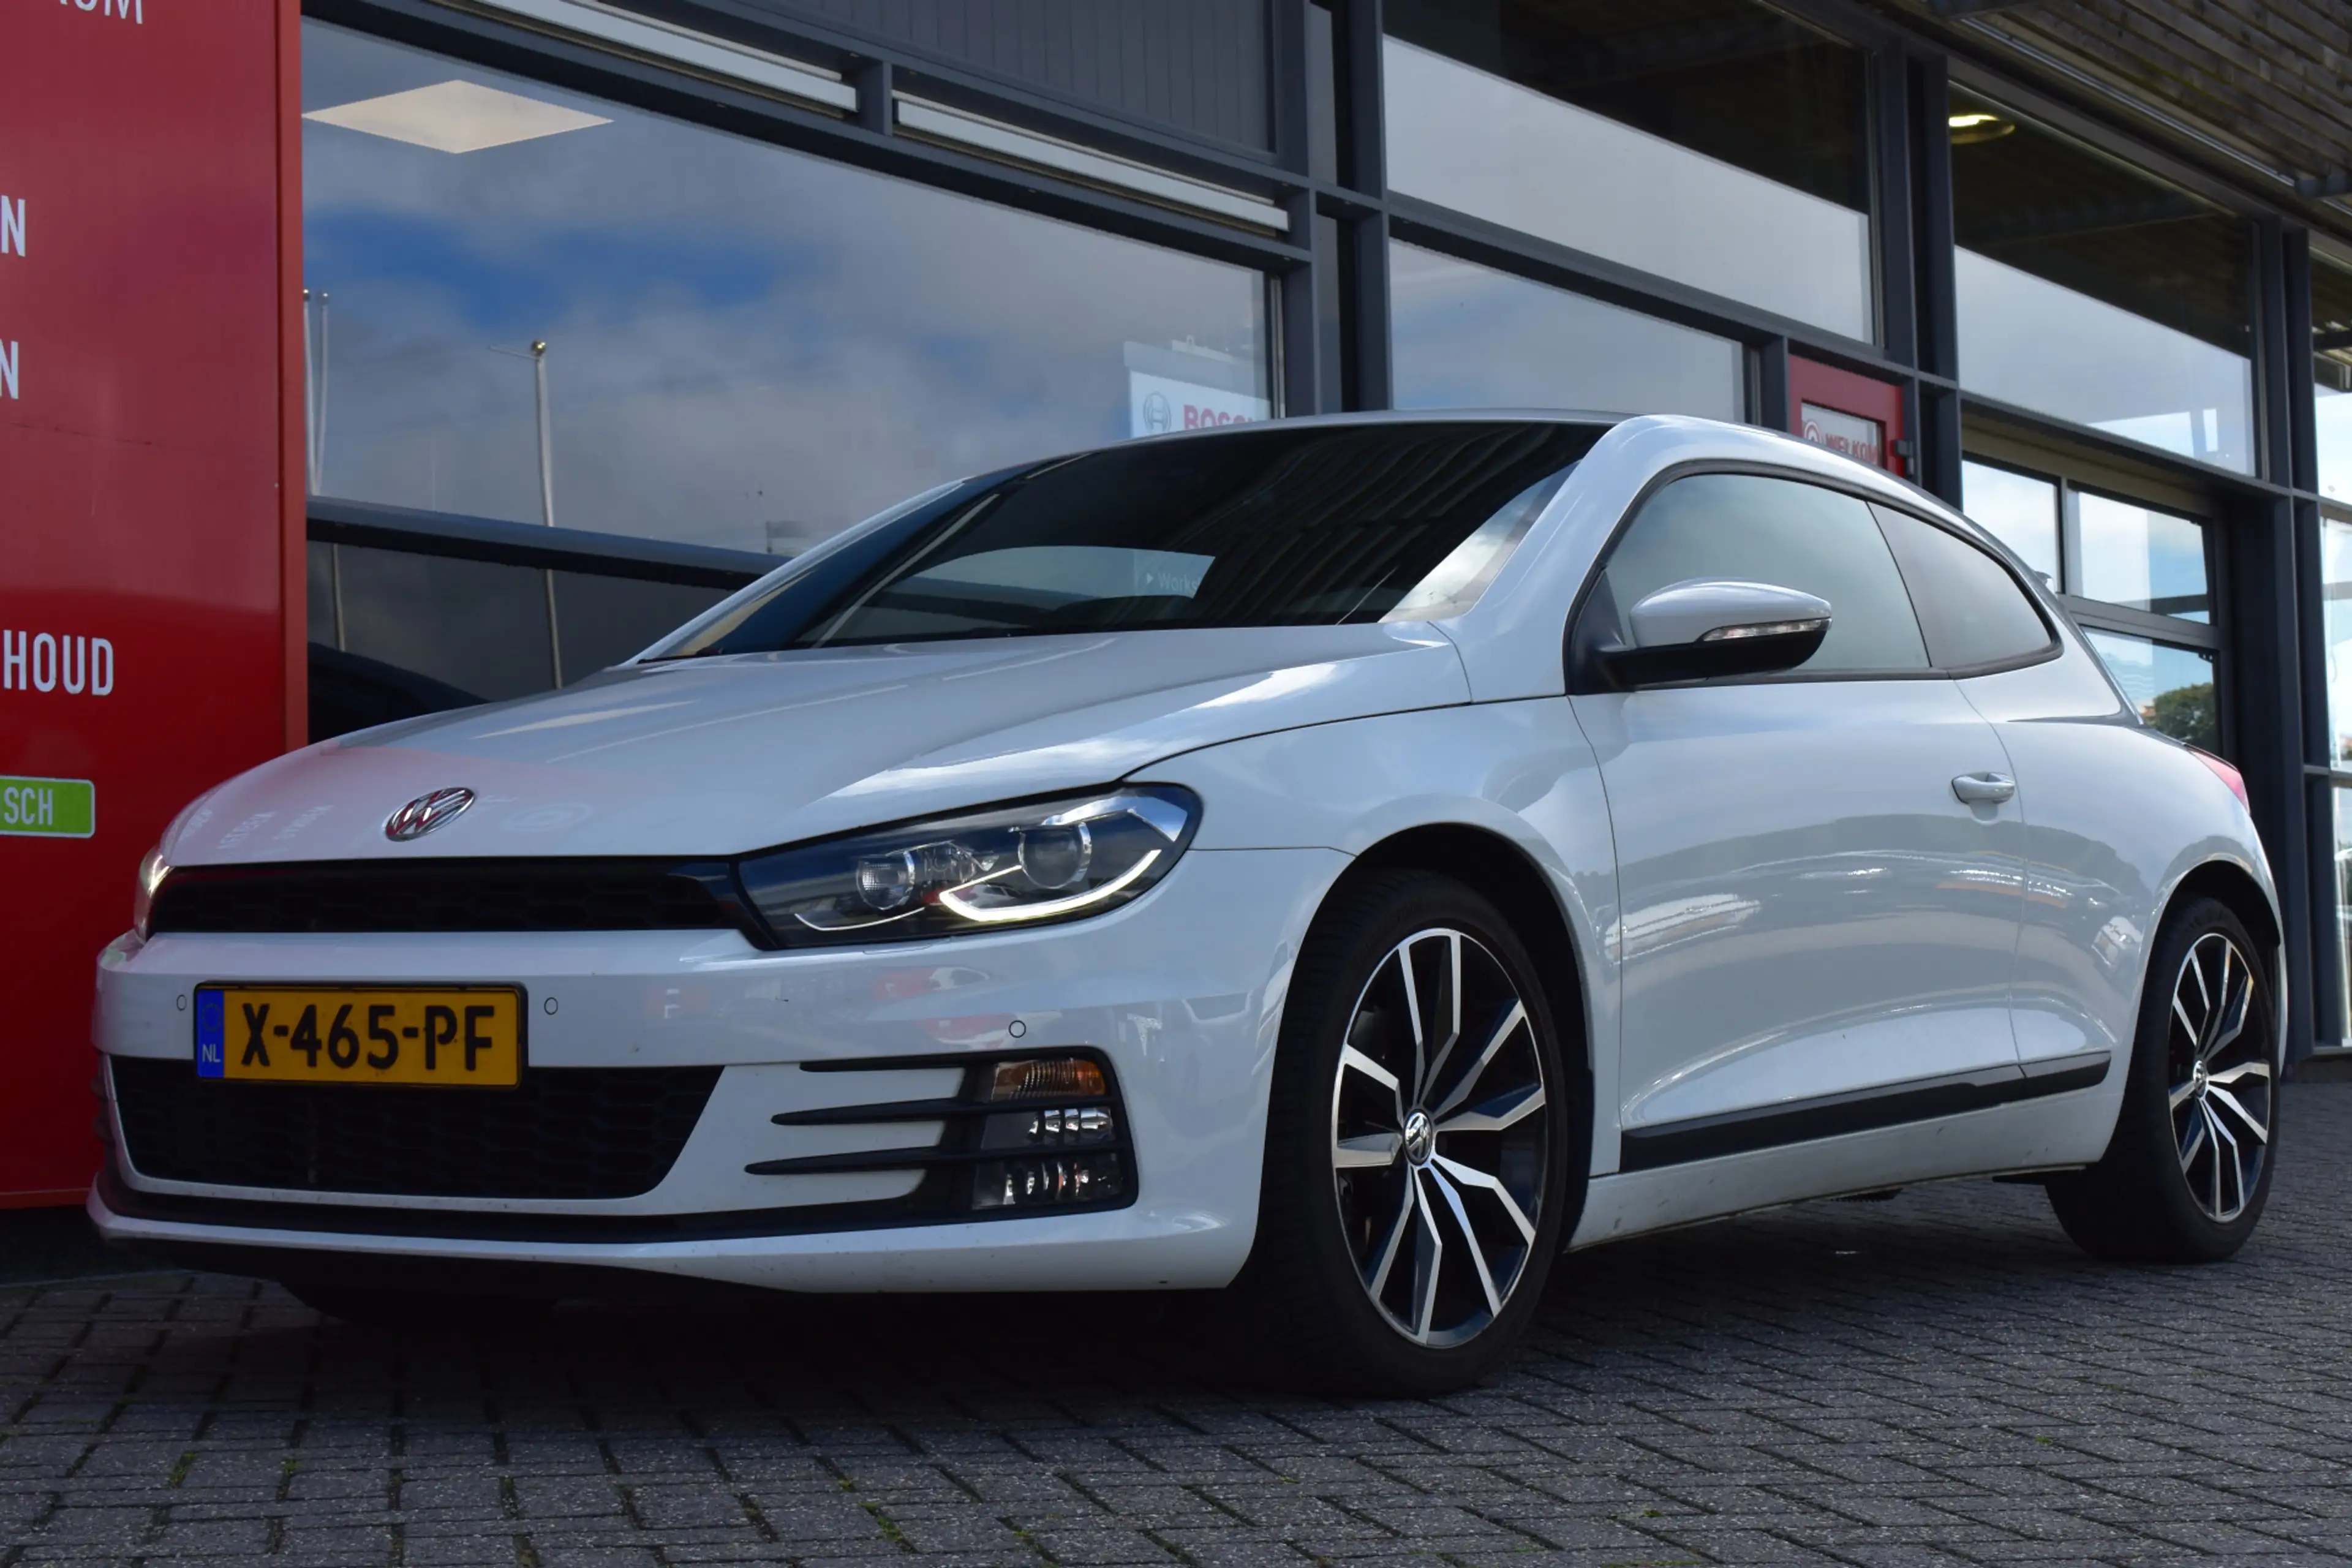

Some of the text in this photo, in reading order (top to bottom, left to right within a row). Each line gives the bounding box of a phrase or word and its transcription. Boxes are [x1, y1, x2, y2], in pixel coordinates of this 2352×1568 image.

[1183, 404, 1253, 430] BOS
[1157, 572, 1202, 594] Works
[2, 629, 115, 696] HOUD
[4, 786, 54, 826] SCH
[202, 1043, 221, 1063] NL
[241, 1002, 495, 1072] X-465-PF
